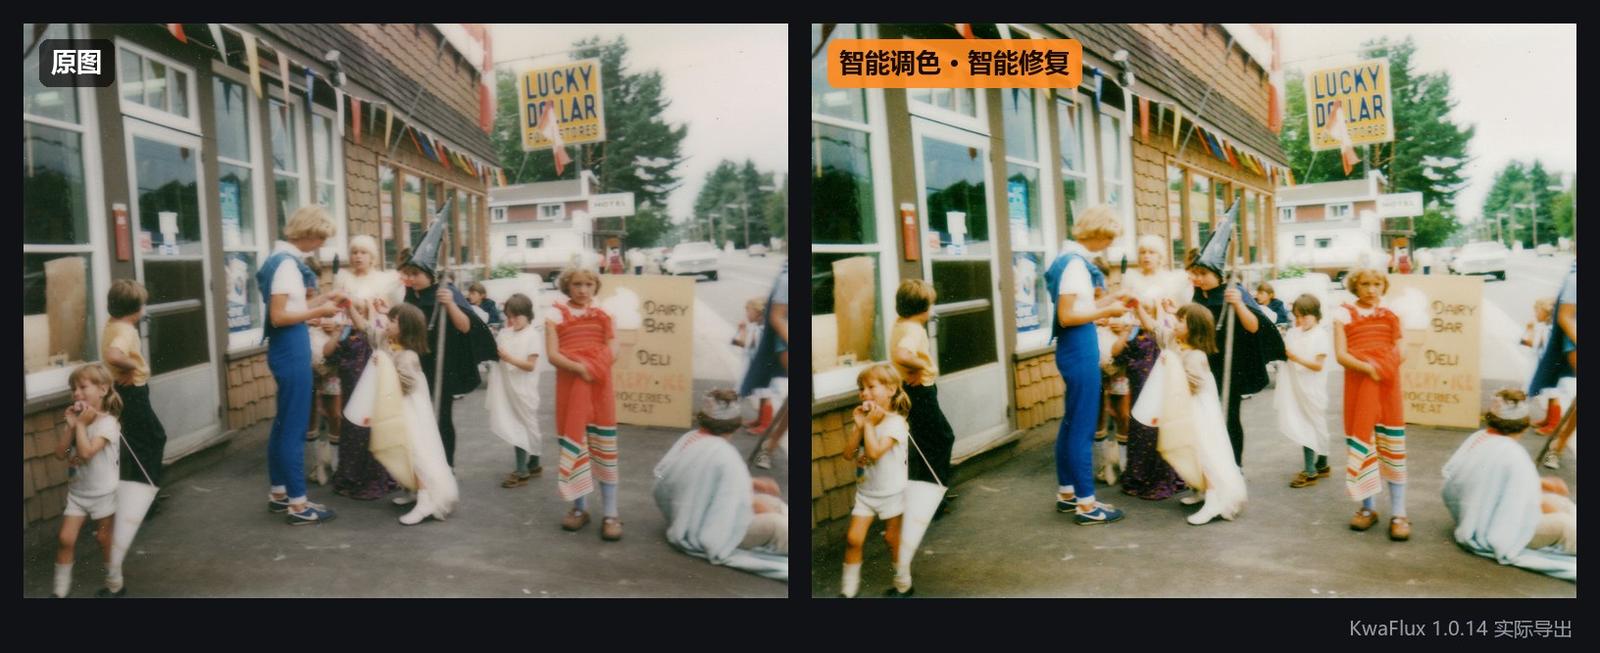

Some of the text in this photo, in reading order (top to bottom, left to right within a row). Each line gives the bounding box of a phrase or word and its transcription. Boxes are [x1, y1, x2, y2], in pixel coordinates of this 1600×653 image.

[525, 64, 592, 99] LUCKY
[1314, 64, 1380, 99] LUCKY
[527, 94, 597, 128] DLAR
[1315, 94, 1385, 128] DLAR
[643, 300, 689, 316] DAIRY
[1431, 300, 1478, 316] DAIRY
[643, 318, 676, 334] BAR
[1431, 318, 1464, 334] BAR
[637, 349, 671, 367] DELI
[1424, 349, 1459, 366] DELI
[615, 371, 652, 389] KERY
[623, 403, 655, 414] MEAT
[1411, 403, 1442, 414] MEAT
